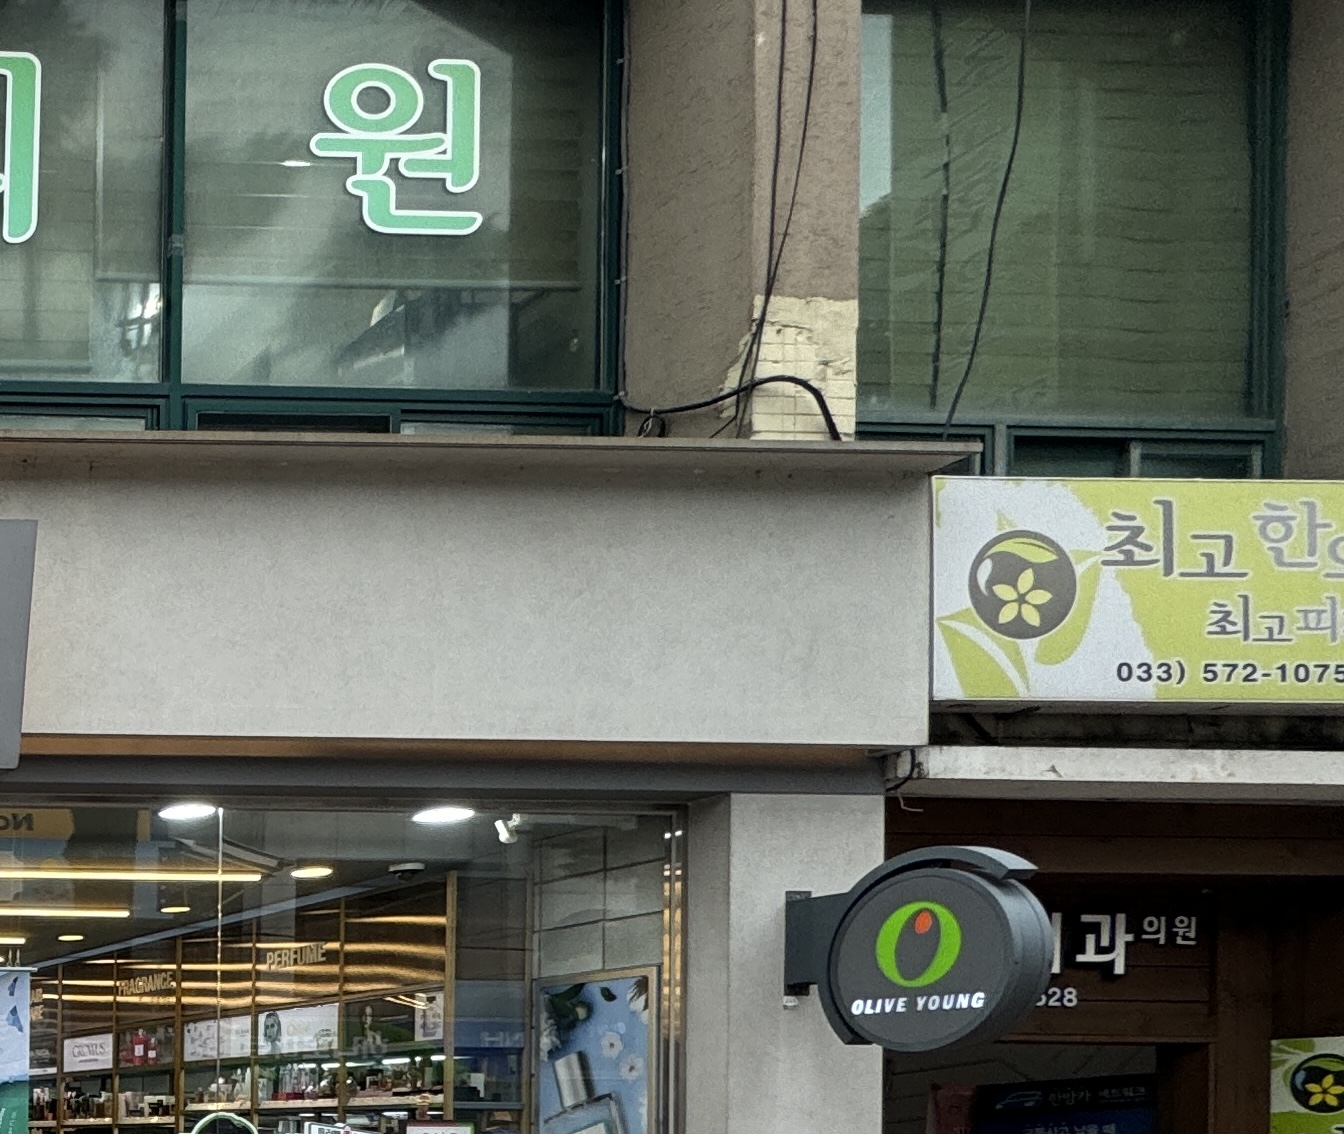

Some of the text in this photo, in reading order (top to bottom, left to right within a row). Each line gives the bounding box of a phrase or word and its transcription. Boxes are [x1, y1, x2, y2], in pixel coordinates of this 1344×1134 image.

[1205, 593, 1344, 644] 최고피
[1116, 661, 1187, 686] 033)
[1141, 915, 1197, 945] 의원
[266, 941, 328, 970] PERFUME
[117, 970, 175, 997] FRAGRANCE
[850, 992, 986, 1016] OLIVE YOUNG
